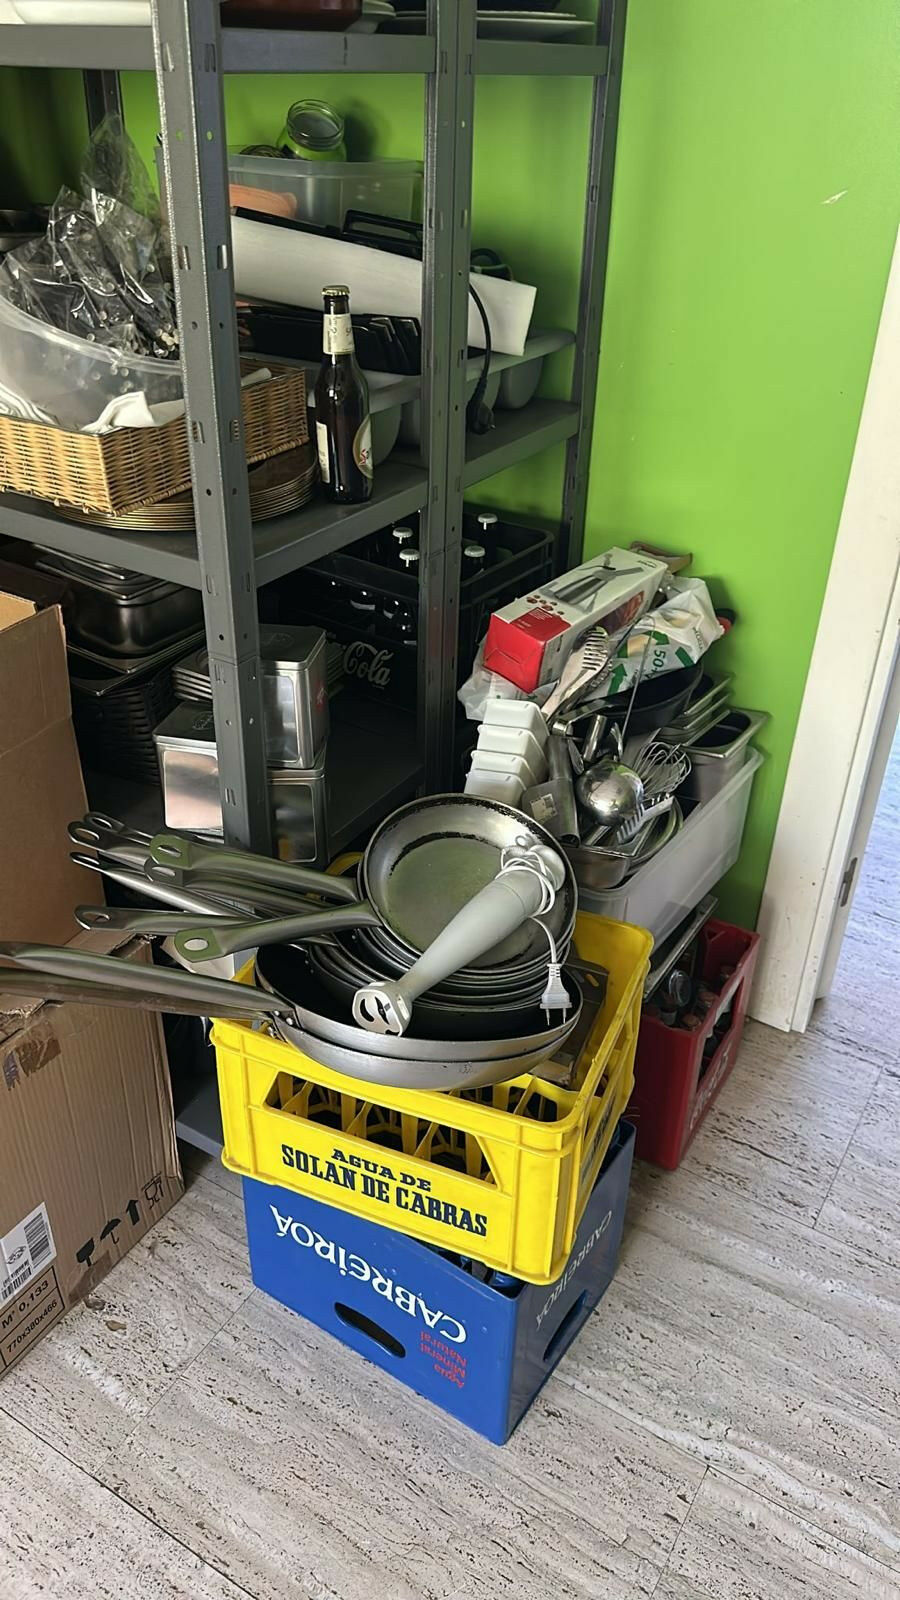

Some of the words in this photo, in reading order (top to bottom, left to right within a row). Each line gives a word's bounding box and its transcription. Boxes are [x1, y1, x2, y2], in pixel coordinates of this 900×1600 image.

[331, 1148, 397, 1181] AGUA
[400, 1172, 432, 1192] DE
[281, 1143, 356, 1191] SOLAN
[361, 1174, 390, 1204] DE
[396, 1186, 488, 1237] CABRAS
[18, 1280, 49, 1313] 0,133
[6, 1300, 58, 1354] 770x380x466
[420, 1331, 467, 1367] Natural
[420, 1343, 466, 1378] Mineral
[434, 1363, 464, 1389] Agua
